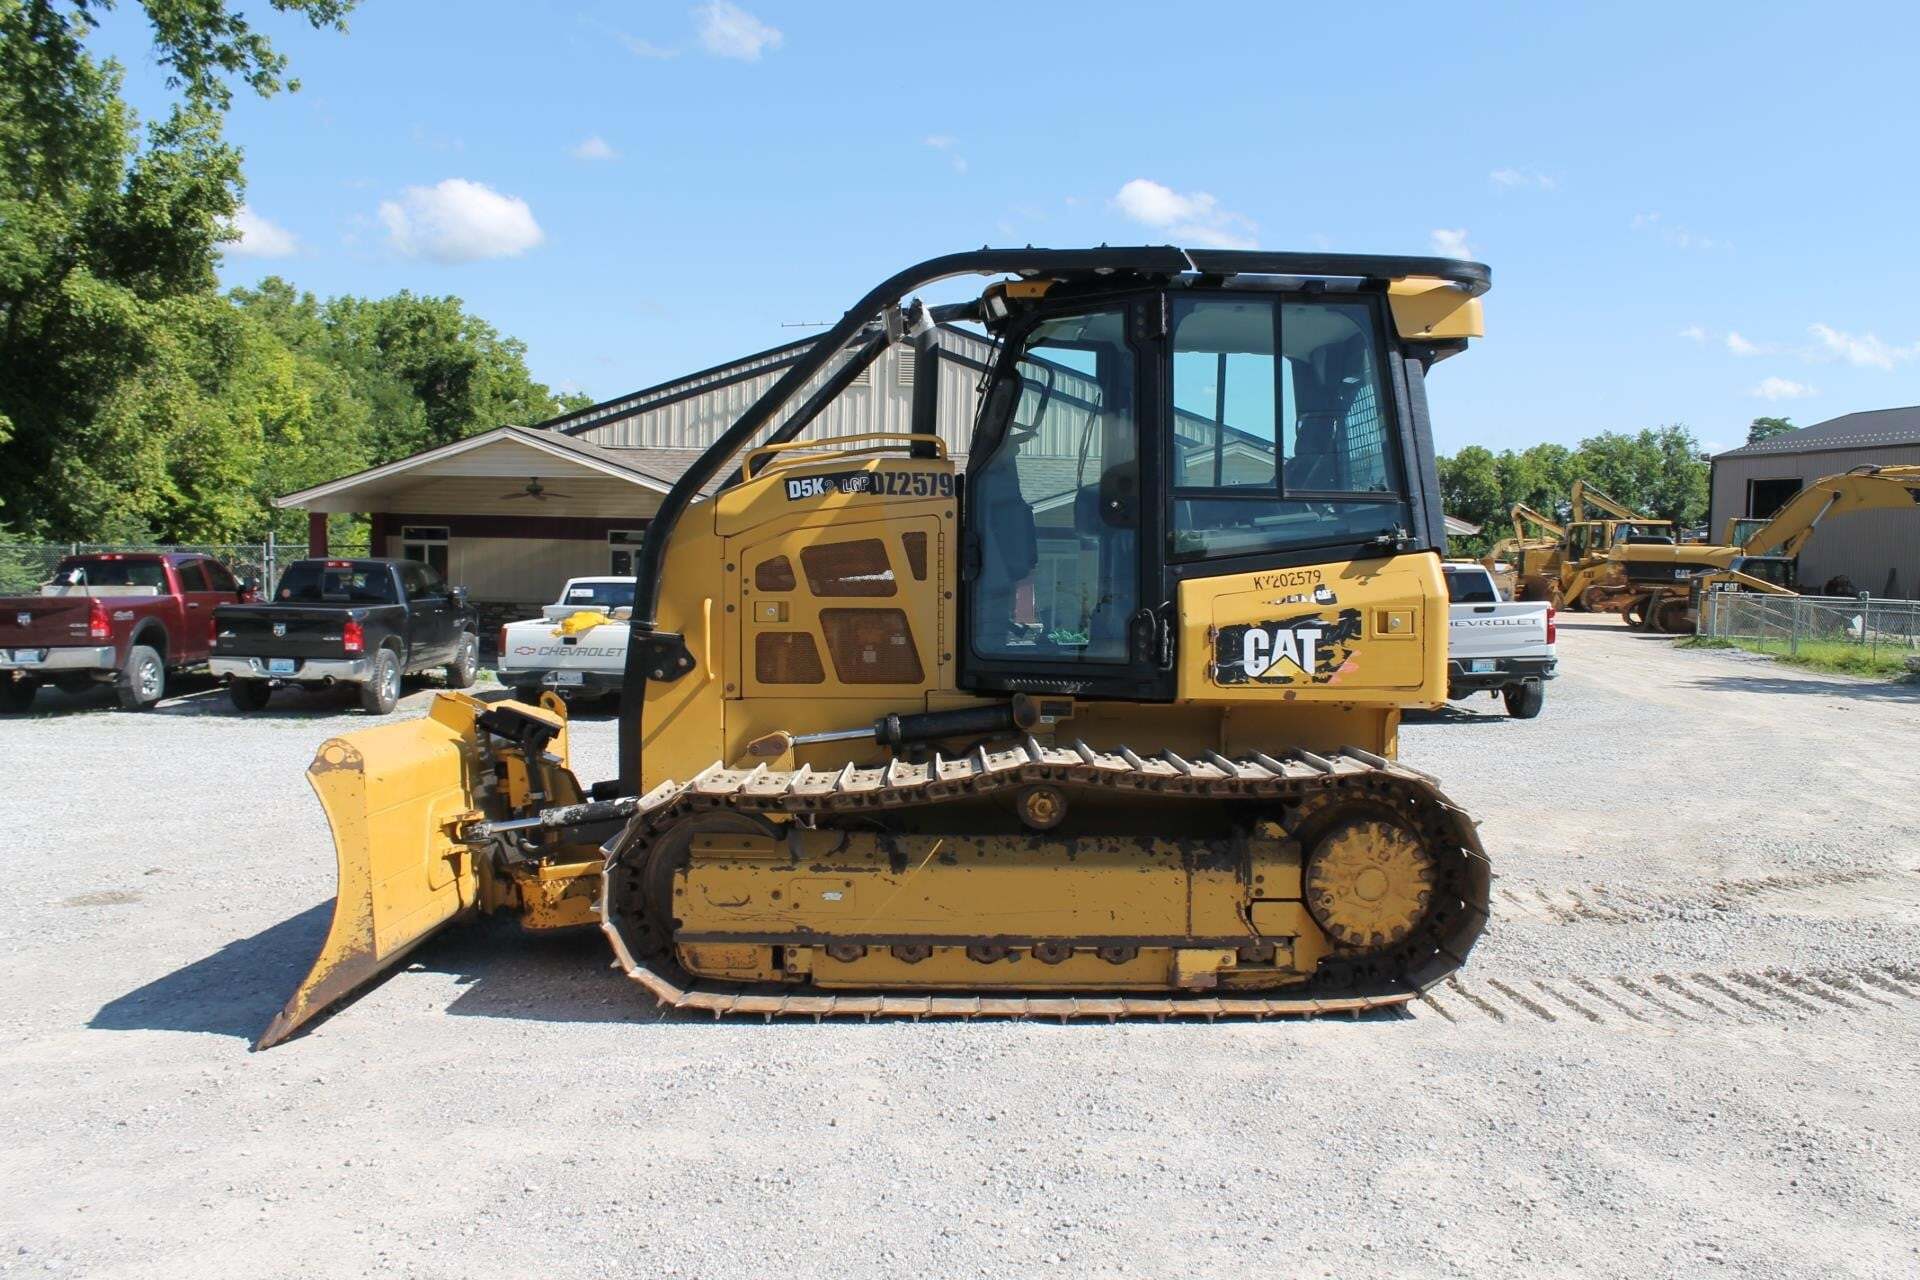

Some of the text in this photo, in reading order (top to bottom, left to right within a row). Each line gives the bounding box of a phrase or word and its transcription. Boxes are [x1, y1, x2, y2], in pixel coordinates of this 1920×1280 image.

[871, 471, 953, 497] DZ2579
[1675, 569, 1691, 578] CAT
[539, 646, 625, 657] CHEVROLET
[1243, 628, 1322, 678] CAT
